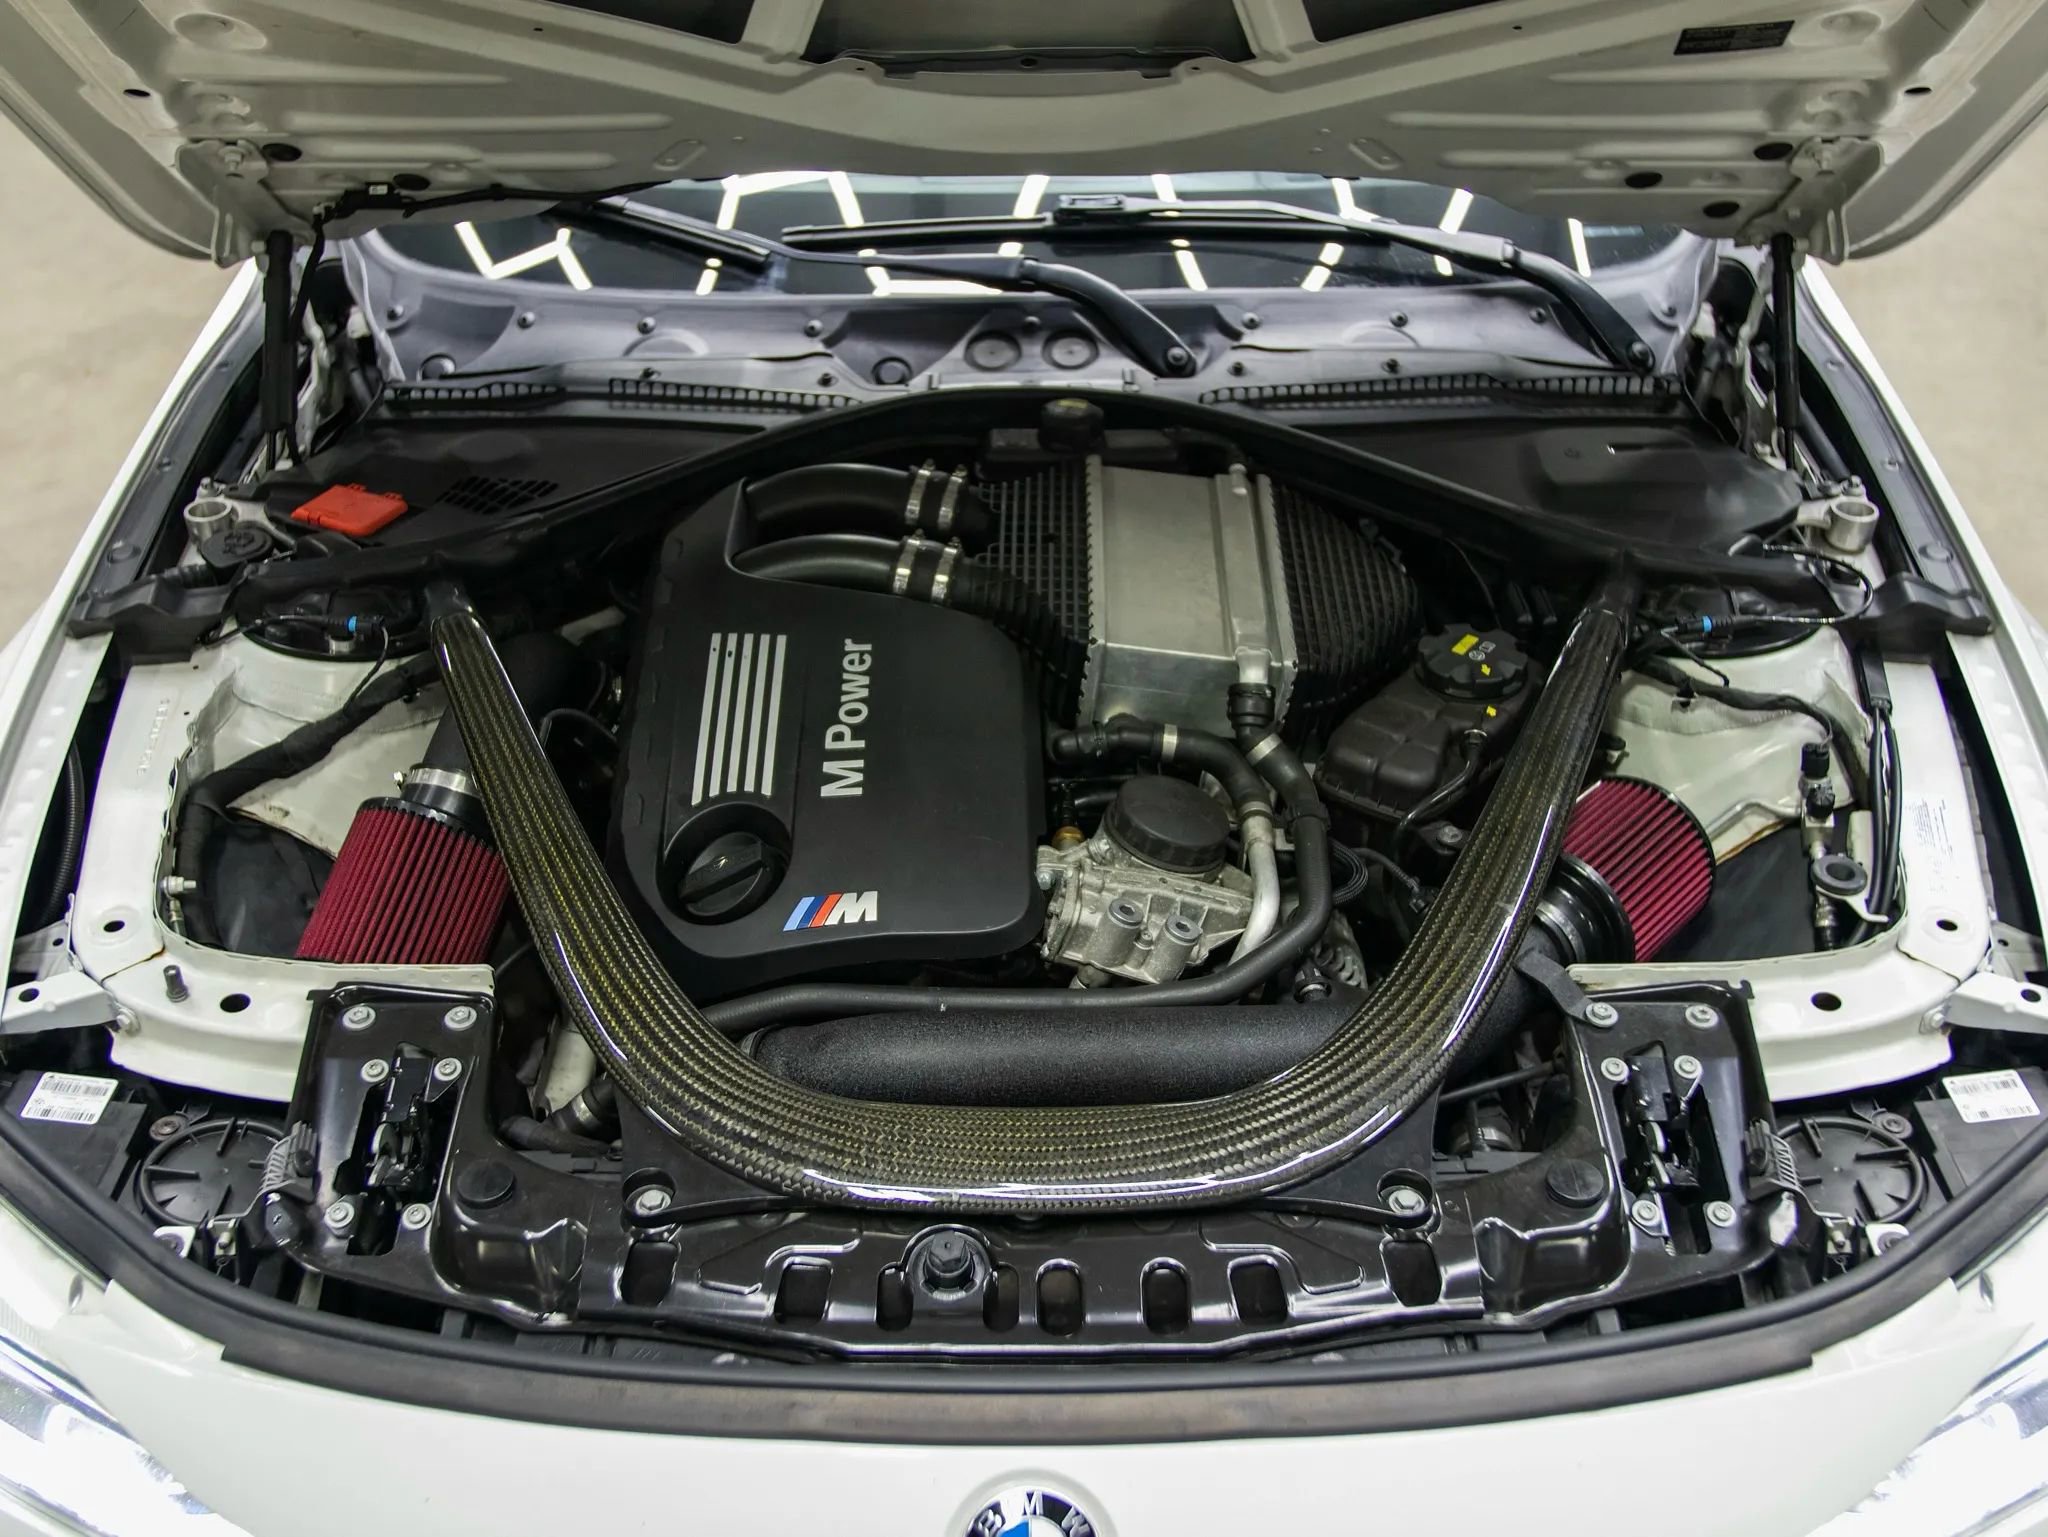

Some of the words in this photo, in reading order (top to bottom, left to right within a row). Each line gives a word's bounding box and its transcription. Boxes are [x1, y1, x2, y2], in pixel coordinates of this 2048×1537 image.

[825, 638, 872, 750] Power
[820, 759, 864, 797] M
[824, 890, 878, 926] M
[977, 1489, 1091, 1537] BMW
